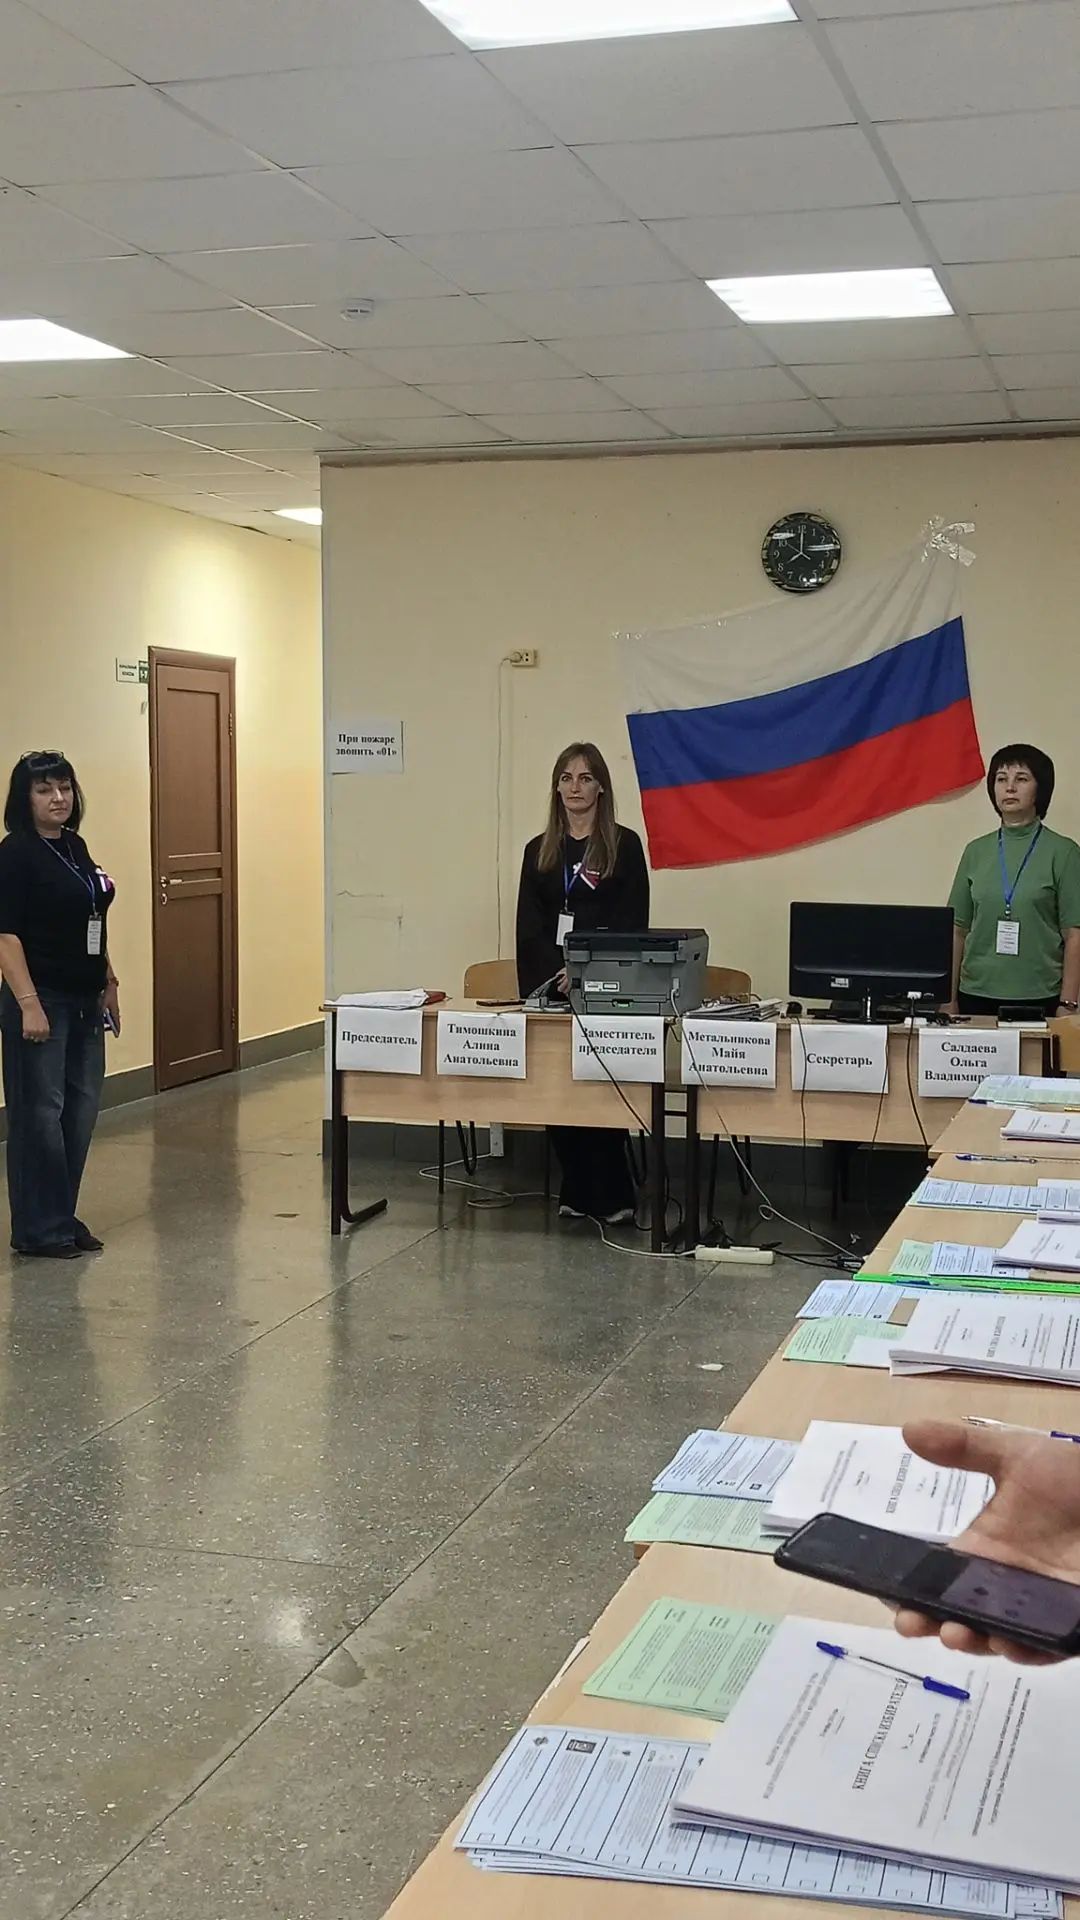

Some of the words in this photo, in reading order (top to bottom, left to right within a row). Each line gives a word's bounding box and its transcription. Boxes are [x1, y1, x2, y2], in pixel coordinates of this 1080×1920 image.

[338, 733, 359, 745] При
[361, 736, 395, 746] пожаре
[335, 748, 374, 756] звонить
[376, 747, 397, 756] «01»
[447, 1023, 517, 1037] Тимошкина
[581, 1027, 656, 1041] Заместитель
[341, 1030, 418, 1046] Председатель
[462, 1039, 500, 1051] Алина
[688, 1031, 771, 1046] Метальникова
[578, 1044, 657, 1057] председателя
[711, 1046, 746, 1059] Майя
[941, 1041, 998, 1054] Салдаева
[443, 1053, 519, 1067] Анатольевна
[806, 1052, 873, 1068] Секретарь
[950, 1057, 988, 1069] Ольга
[688, 1061, 769, 1076] Анатольевна
[924, 1070, 987, 1085] Владимир
[851, 1761, 875, 1790] КНИГА
